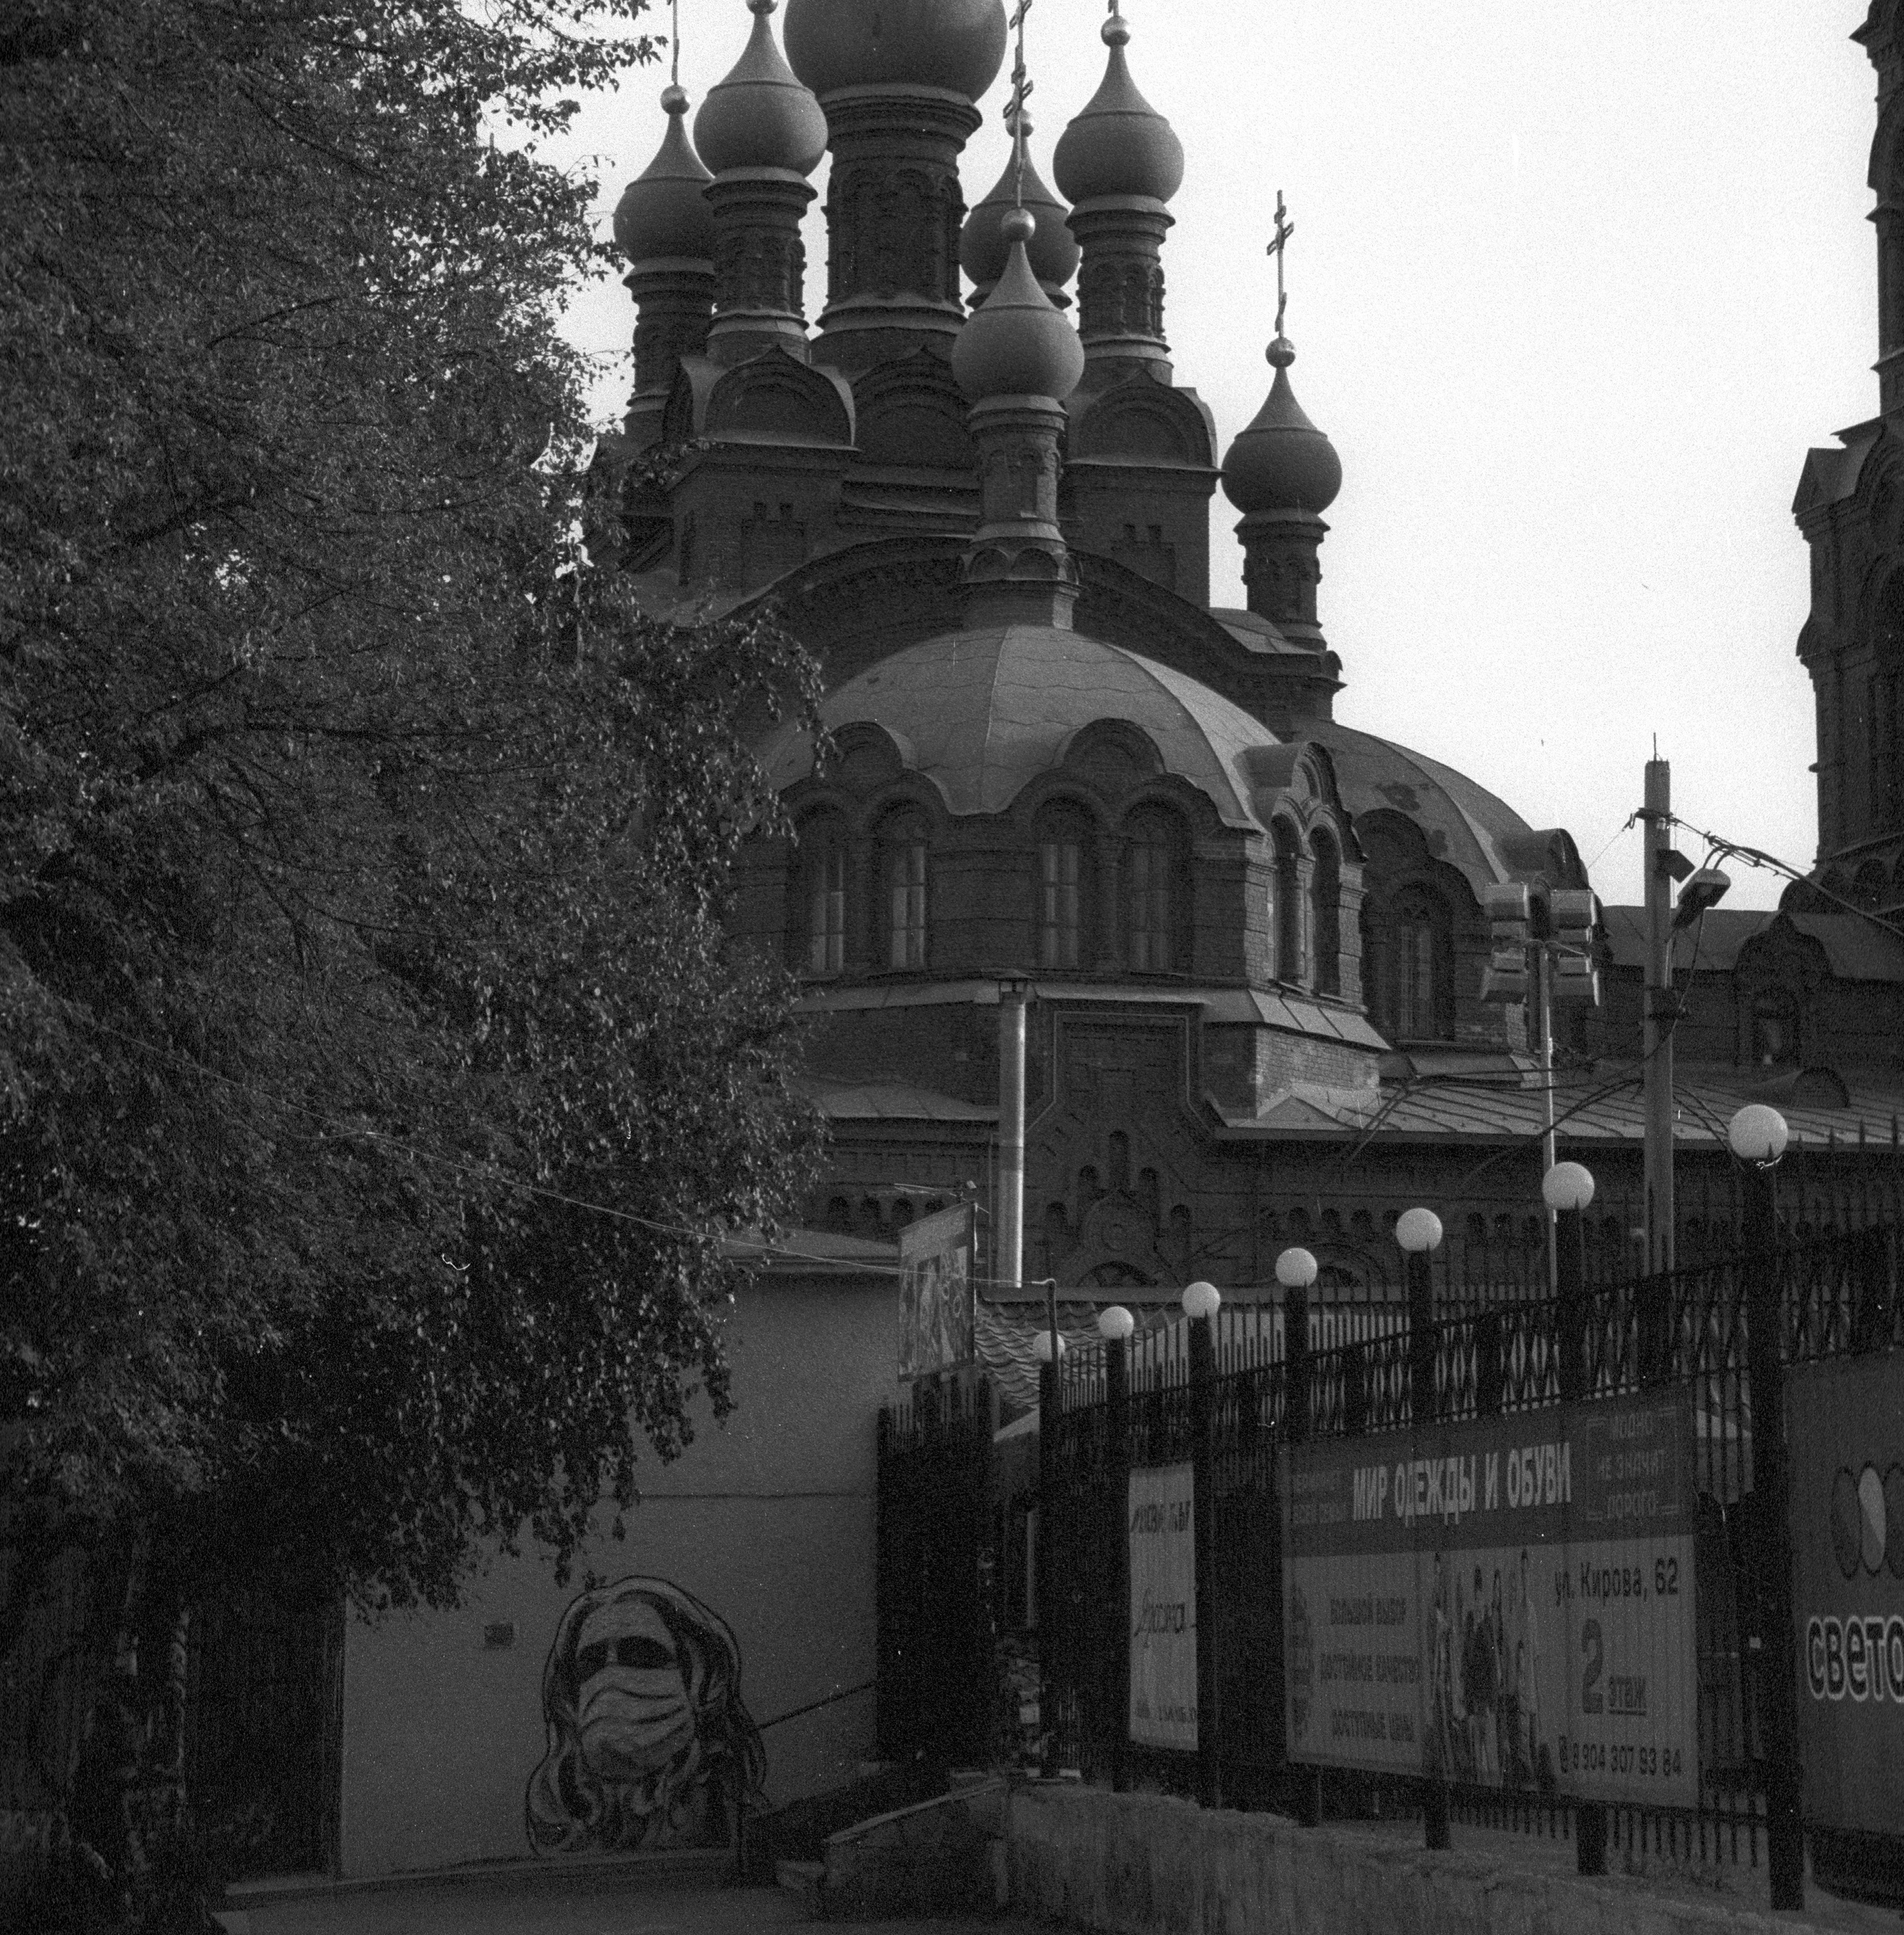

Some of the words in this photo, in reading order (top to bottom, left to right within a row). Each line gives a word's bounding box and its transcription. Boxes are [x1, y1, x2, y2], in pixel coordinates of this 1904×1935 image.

[1353, 1465, 1388, 1521] МИР
[1395, 1454, 1476, 1528] ОДЕЖДЫ
[1485, 1451, 1499, 1510] И
[1507, 1442, 1572, 1508] ОБУВИ
[1554, 1570, 1575, 1607] ул.
[1580, 1562, 1647, 1606] Кирова,
[1655, 1557, 1679, 1595] 62
[1581, 1618, 1604, 1714] 2
[1608, 1675, 1647, 1709] этаж
[1582, 1743, 1606, 1771] 904
[1611, 1745, 1635, 1773] 307
[1639, 1747, 1657, 1776] 93
